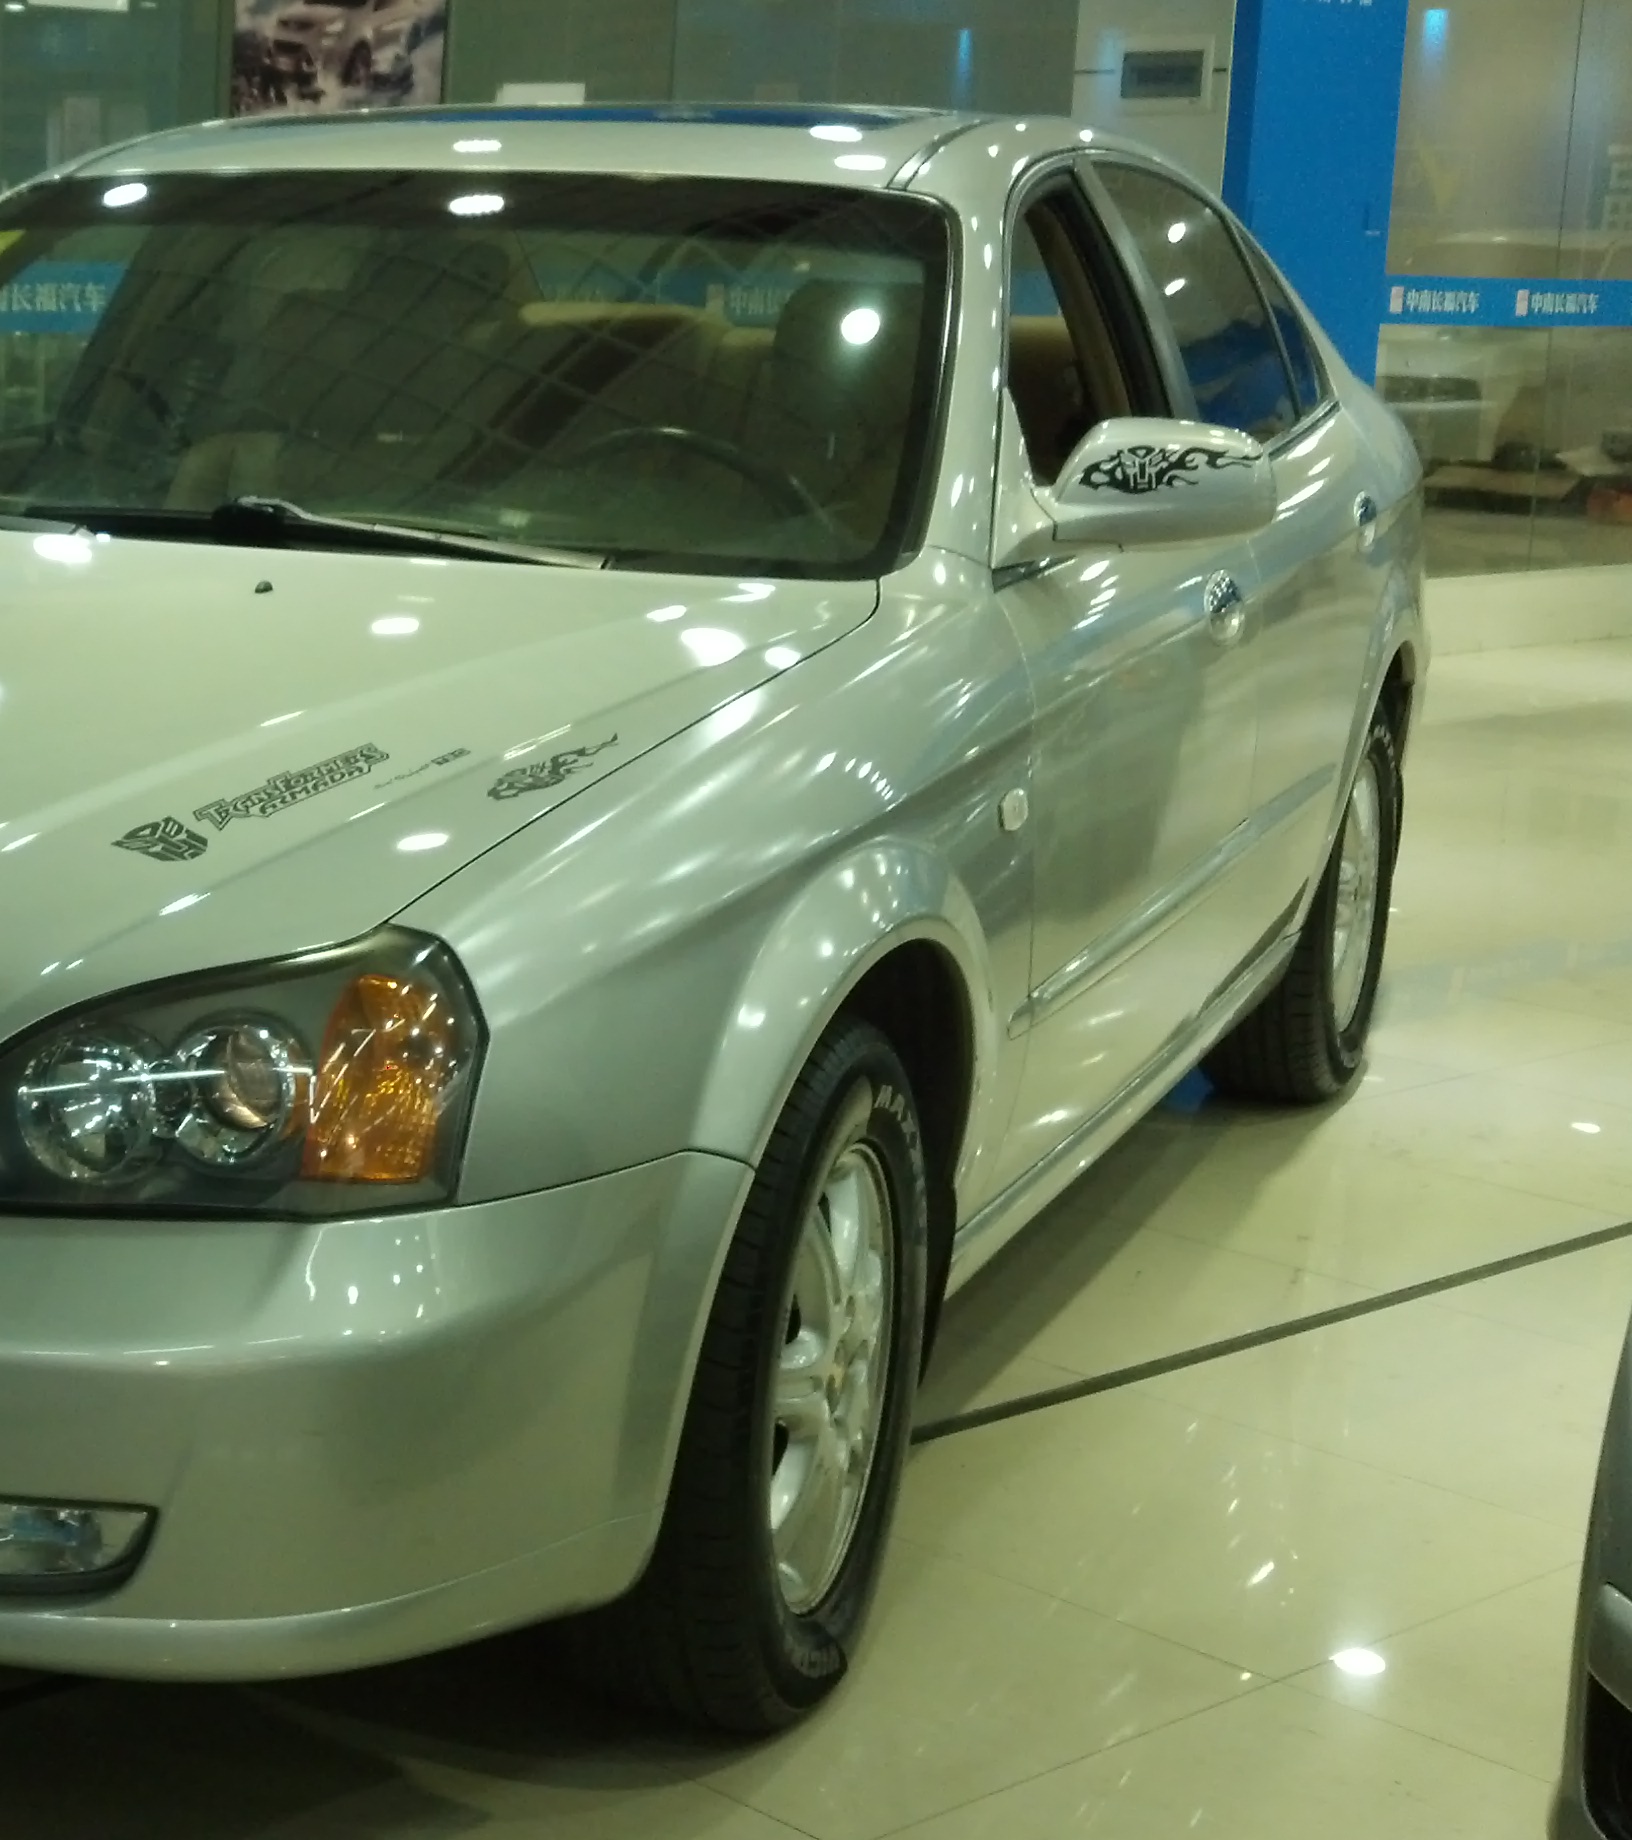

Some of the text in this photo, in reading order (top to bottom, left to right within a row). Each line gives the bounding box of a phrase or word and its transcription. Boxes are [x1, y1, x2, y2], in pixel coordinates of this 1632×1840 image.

[1405, 289, 1480, 313] 中南长福汽车
[1530, 292, 1599, 314] 中南长福汽车
